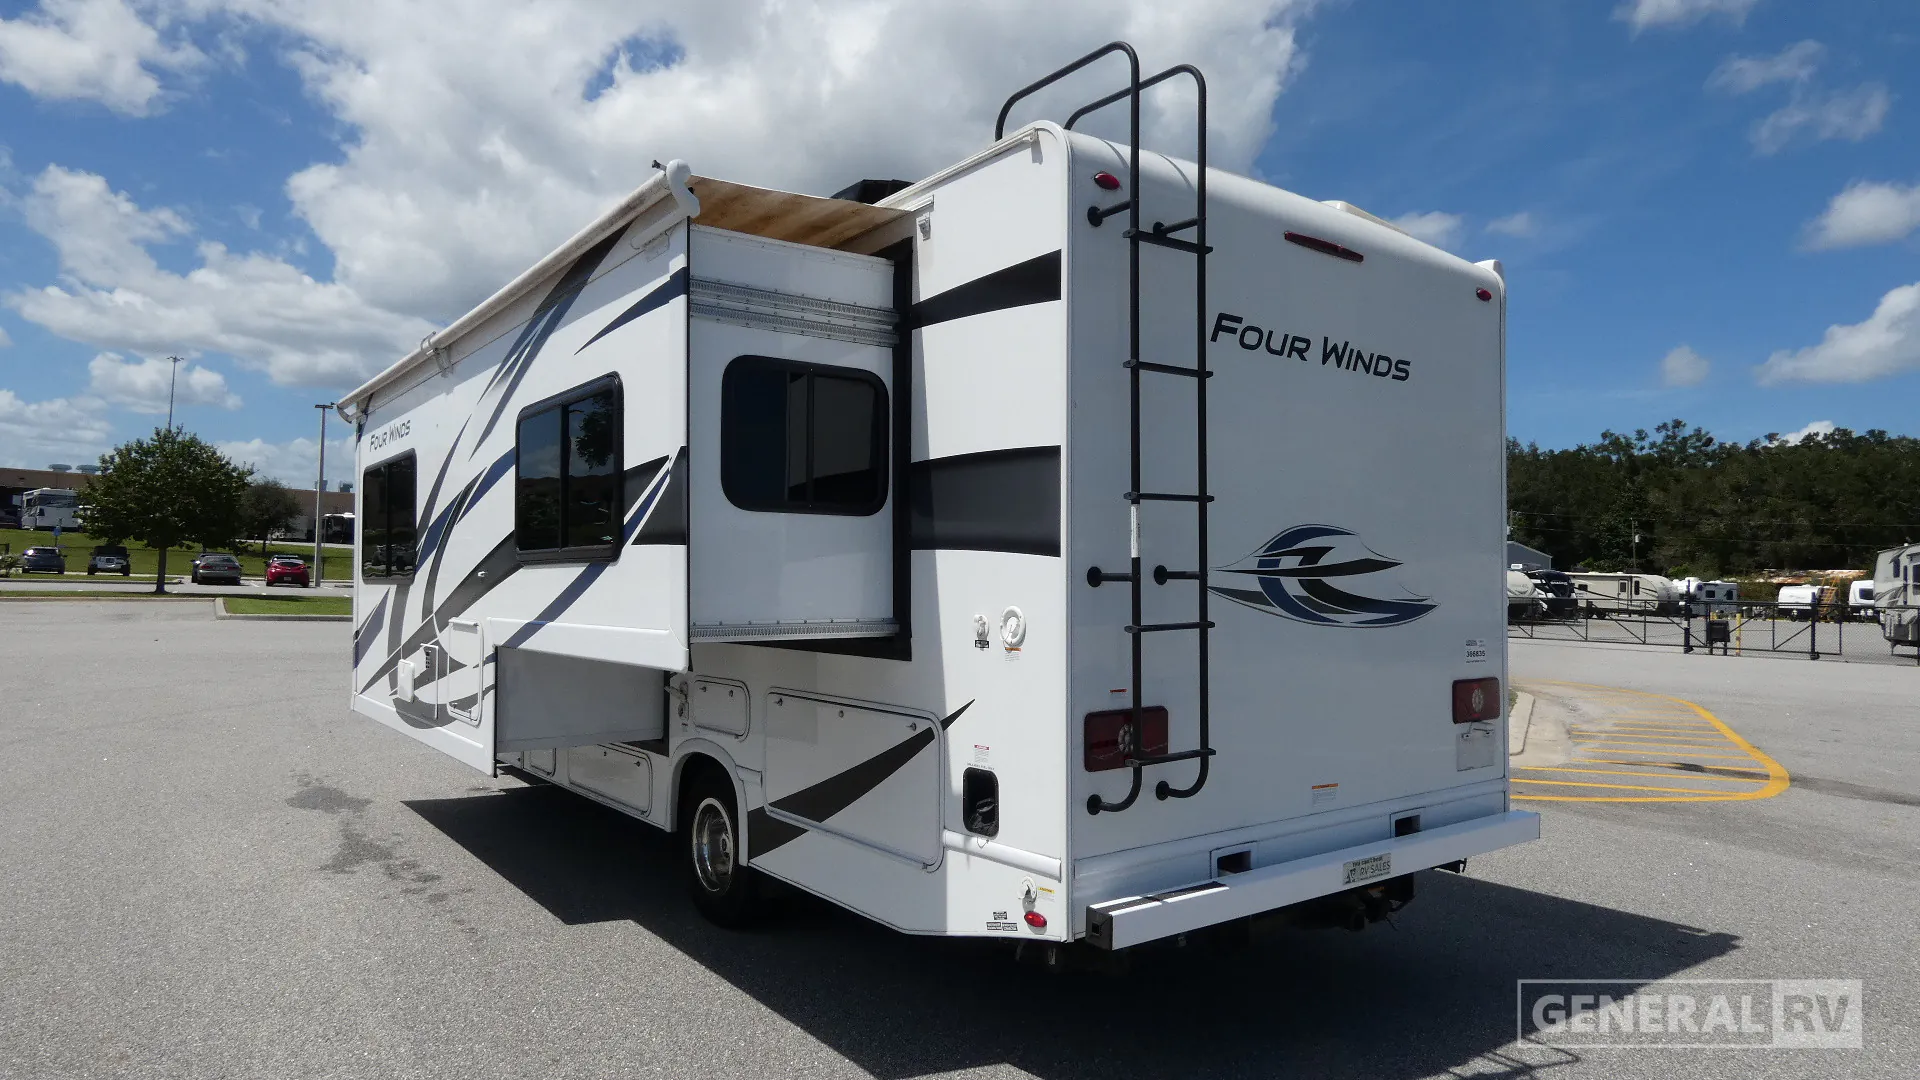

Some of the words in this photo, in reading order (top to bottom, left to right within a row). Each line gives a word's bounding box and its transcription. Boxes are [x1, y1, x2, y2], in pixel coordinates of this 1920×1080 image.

[1210, 312, 1311, 361] FOUR
[1322, 336, 1411, 381] WINDS
[370, 432, 387, 452] FOUR
[389, 420, 410, 444] WINDS
[1371, 861, 1390, 873] SALES
